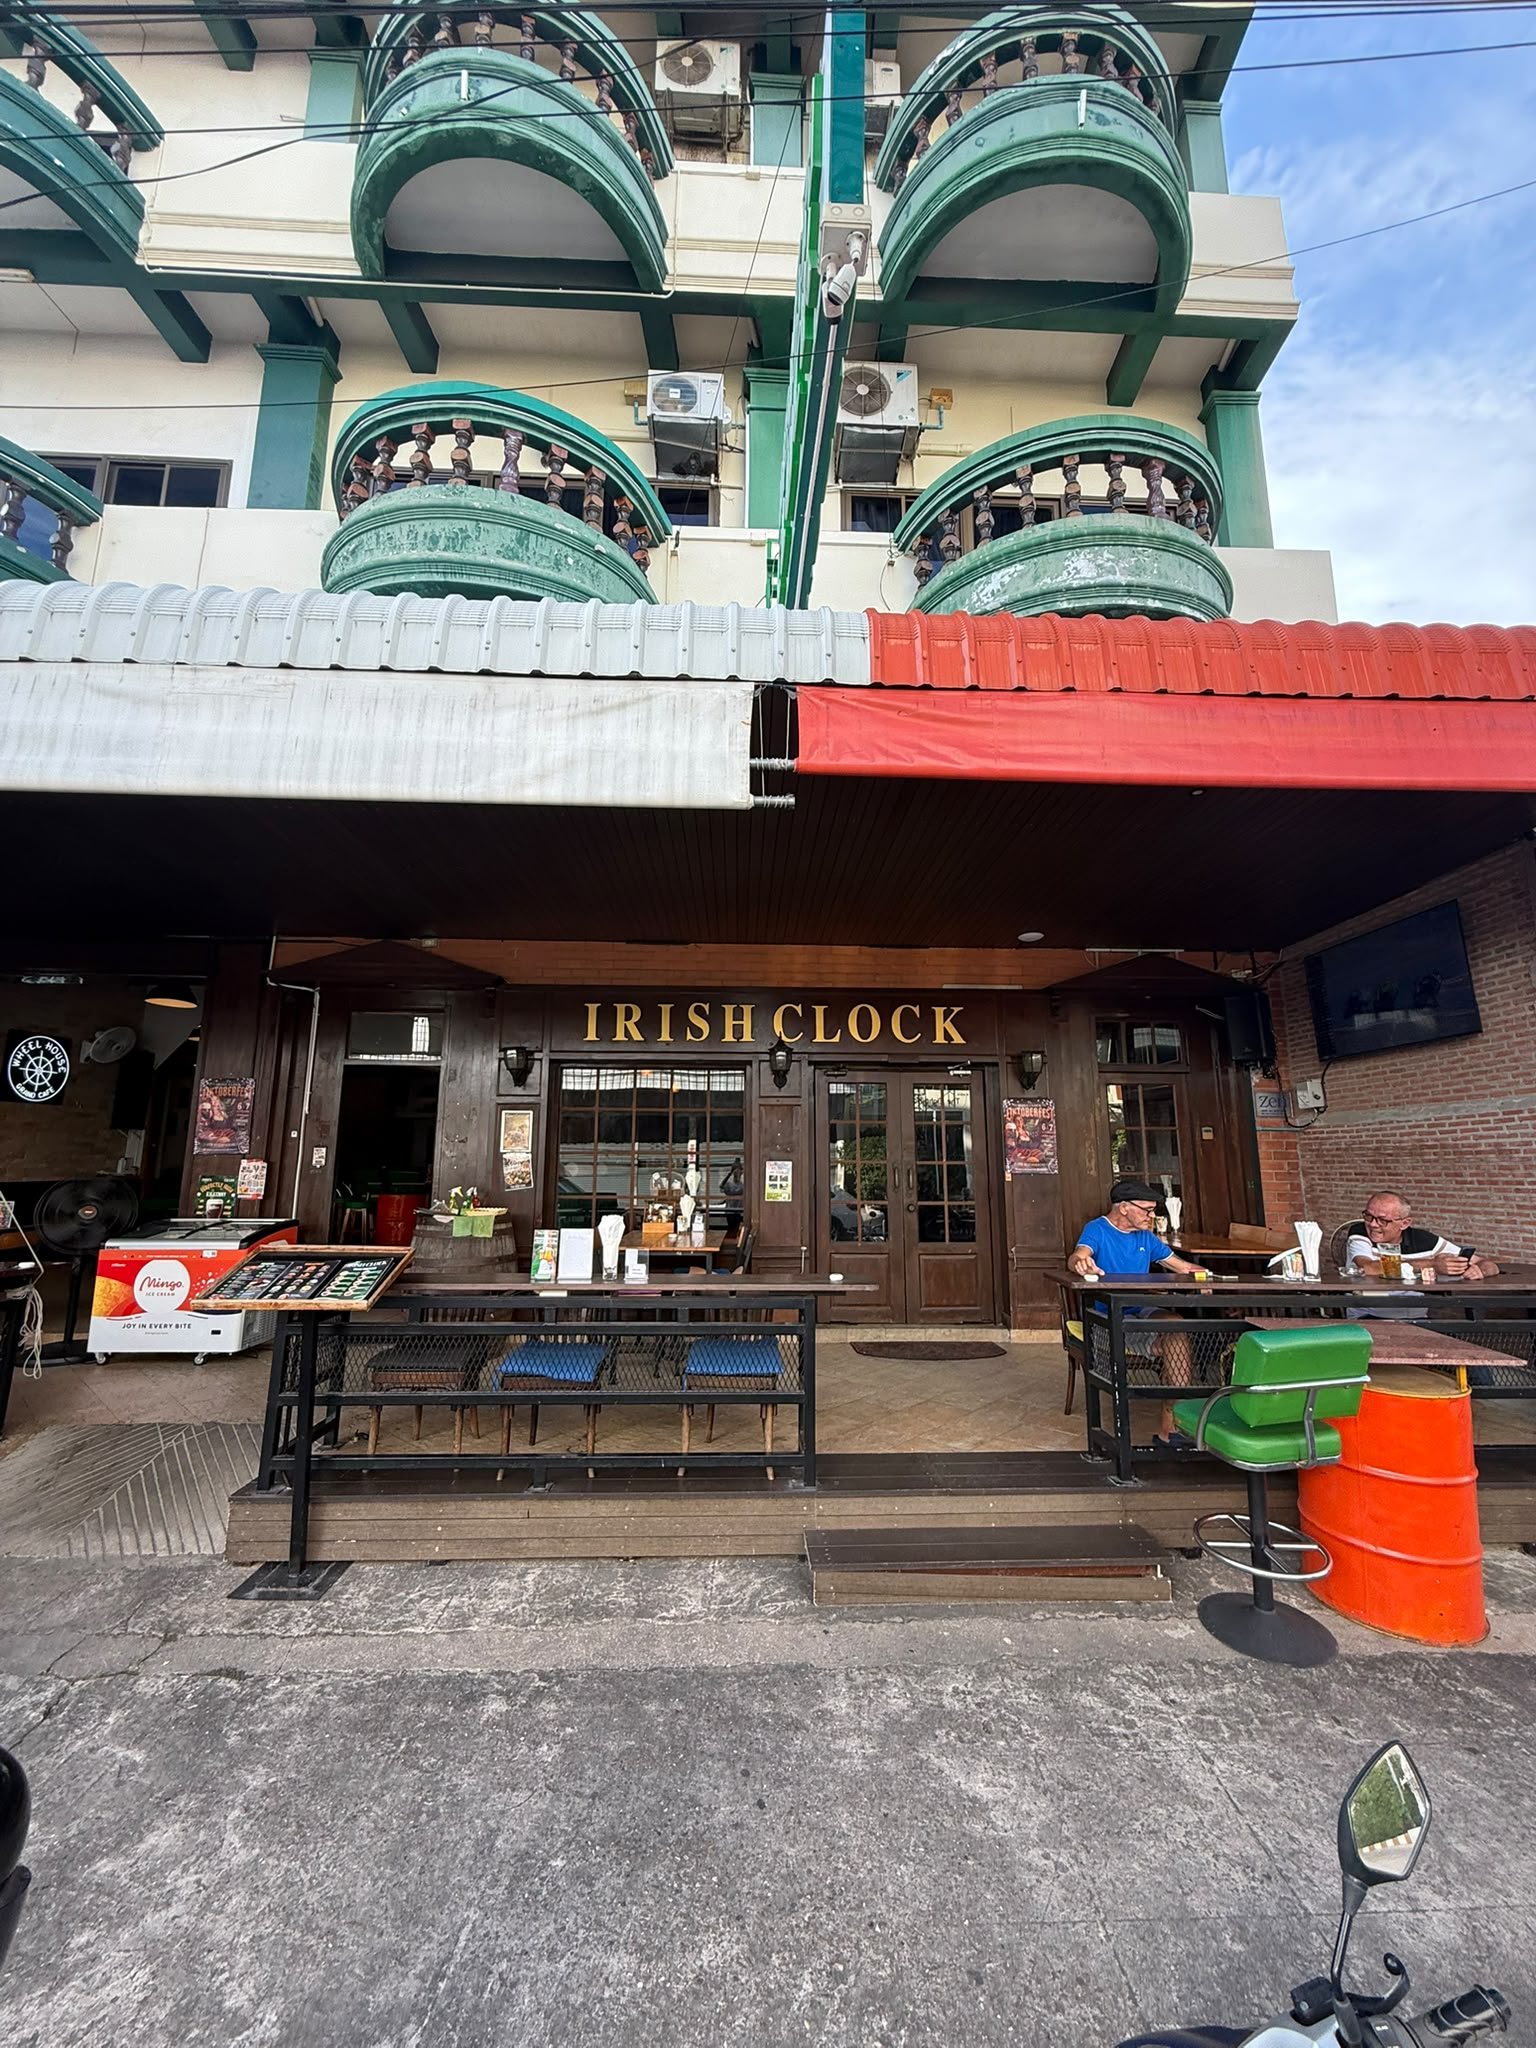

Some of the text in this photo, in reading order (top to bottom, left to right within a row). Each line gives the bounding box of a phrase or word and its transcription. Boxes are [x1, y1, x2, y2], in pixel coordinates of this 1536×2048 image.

[583, 1003, 967, 1044] IRISH CLOCK
[11, 1040, 67, 1074] WHEEL HOUSE
[16, 1082, 36, 1099] GRAND
[202, 1086, 252, 1100] OKTOBERFEST
[1006, 1106, 1053, 1121] OKTOBERFEST
